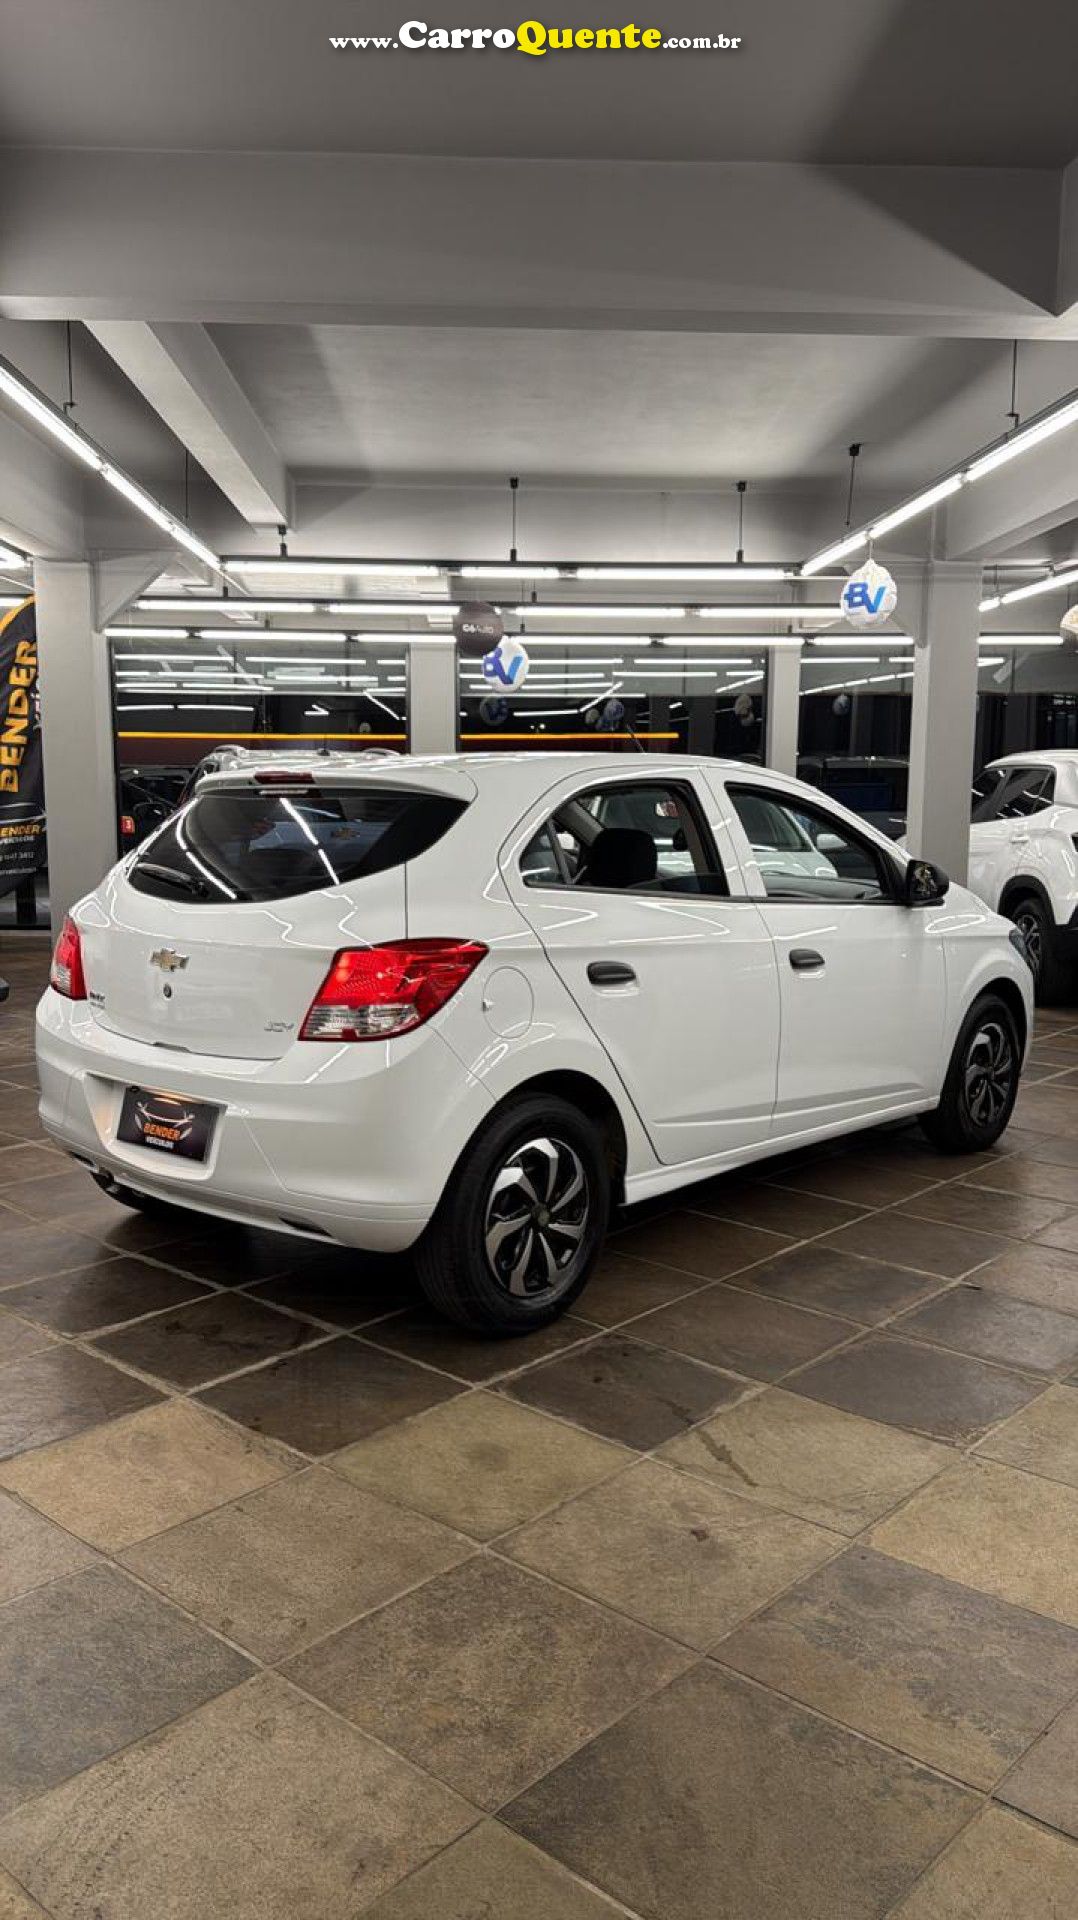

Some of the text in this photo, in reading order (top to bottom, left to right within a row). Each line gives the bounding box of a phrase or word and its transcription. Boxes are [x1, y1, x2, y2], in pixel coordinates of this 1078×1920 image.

[844, 582, 886, 614] BV
[0, 641, 37, 793] BENDER
[0, 824, 40, 836] ENDER
[143, 1122, 181, 1141] BENDER
